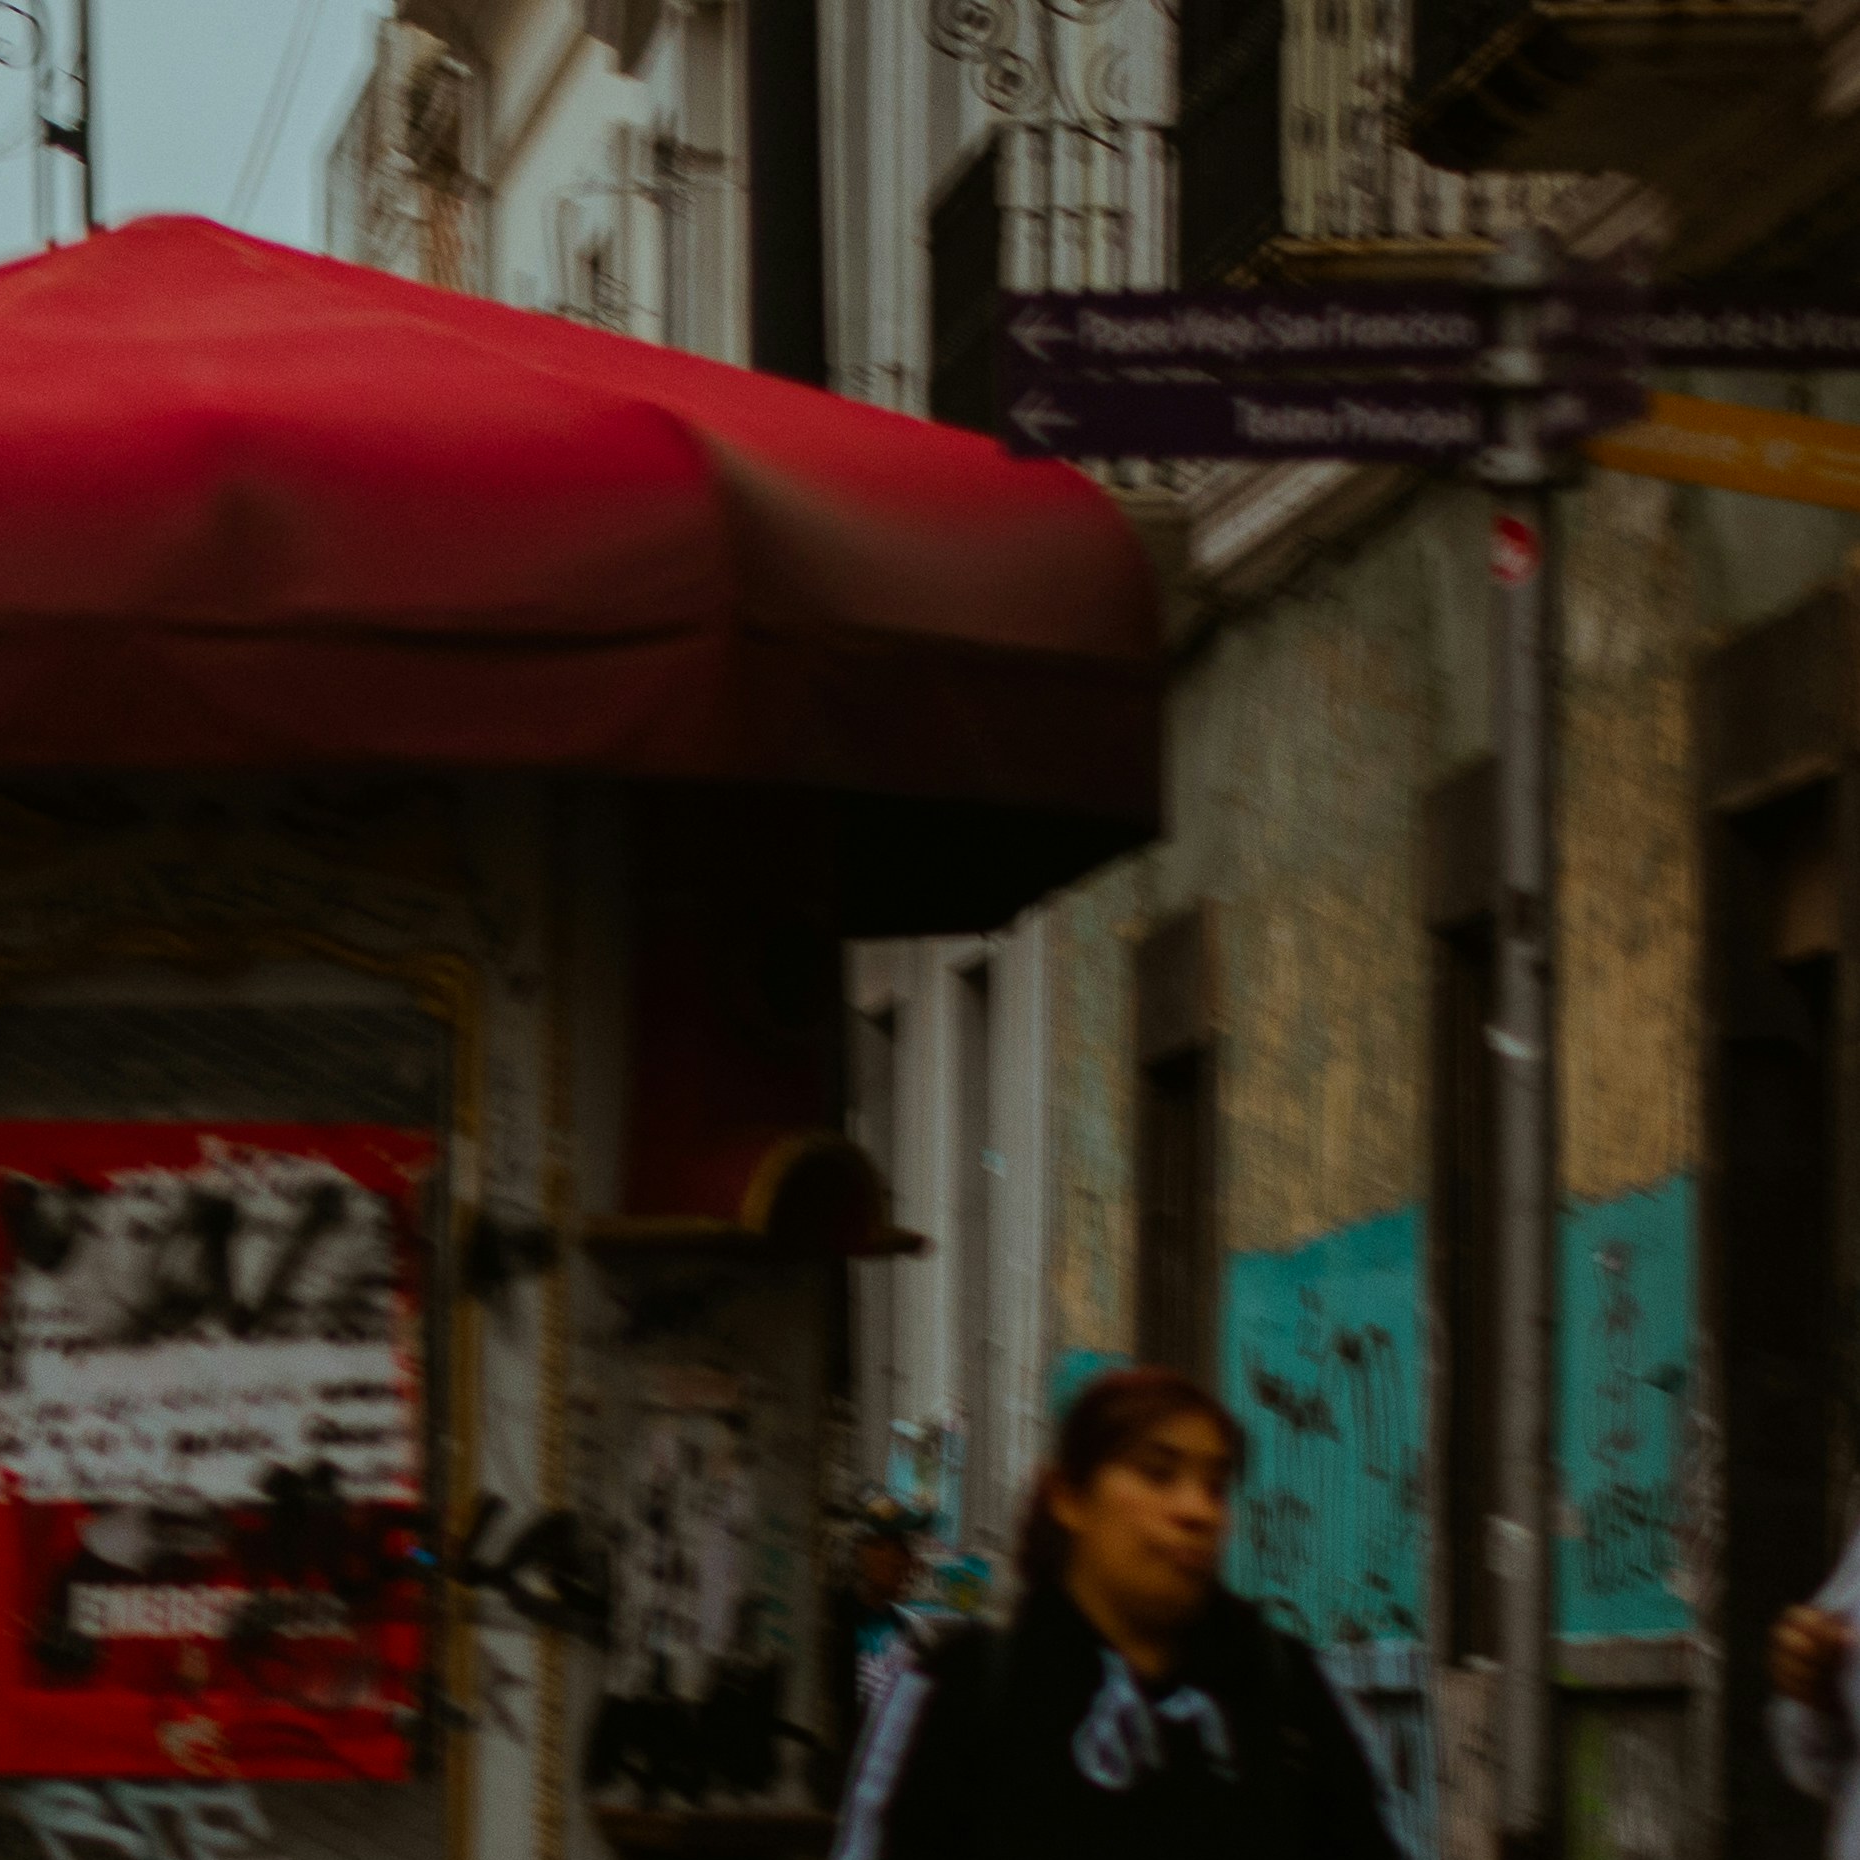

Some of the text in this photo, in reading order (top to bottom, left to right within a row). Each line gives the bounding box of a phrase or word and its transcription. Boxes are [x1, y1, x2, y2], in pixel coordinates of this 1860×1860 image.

[1083, 306, 1477, 359] Paseo Viejo San Francisco
[1237, 399, 1479, 449] Teatro Principal
